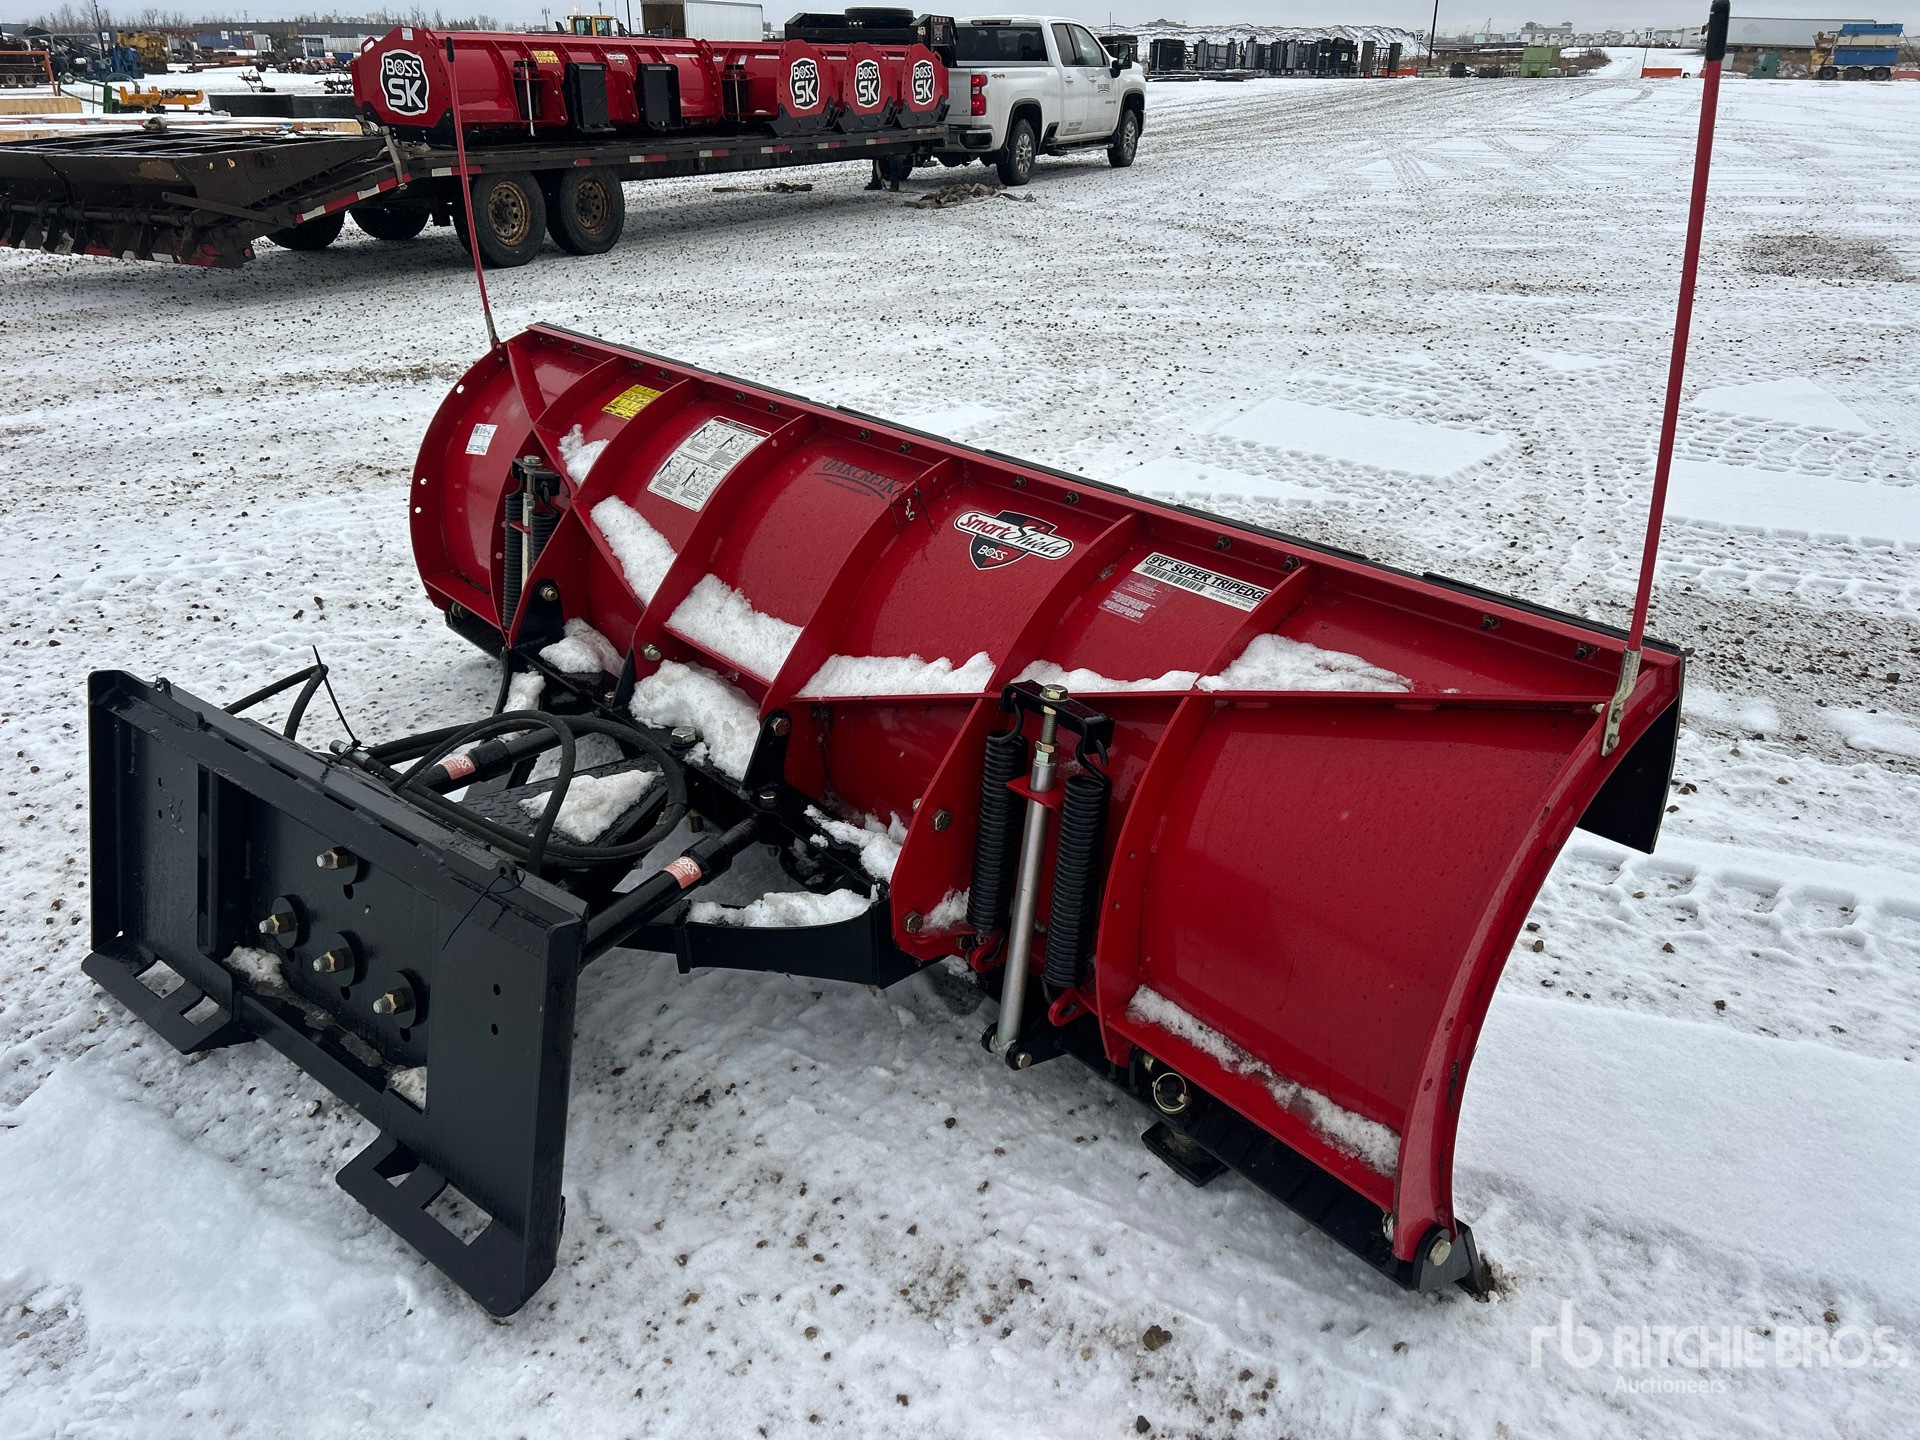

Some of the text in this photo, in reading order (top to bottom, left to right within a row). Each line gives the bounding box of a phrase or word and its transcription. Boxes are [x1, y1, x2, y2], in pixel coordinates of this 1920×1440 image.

[385, 58, 420, 77] BOSS
[793, 65, 815, 80] BOSS
[858, 66, 877, 80] BOSS
[915, 66, 931, 79] BOSS
[388, 78, 424, 108] SK
[795, 80, 816, 104] SK
[858, 80, 877, 102] SK
[915, 79, 931, 100] SK
[977, 545, 1008, 561] BOSS
[1171, 564, 1211, 582] SUPER
